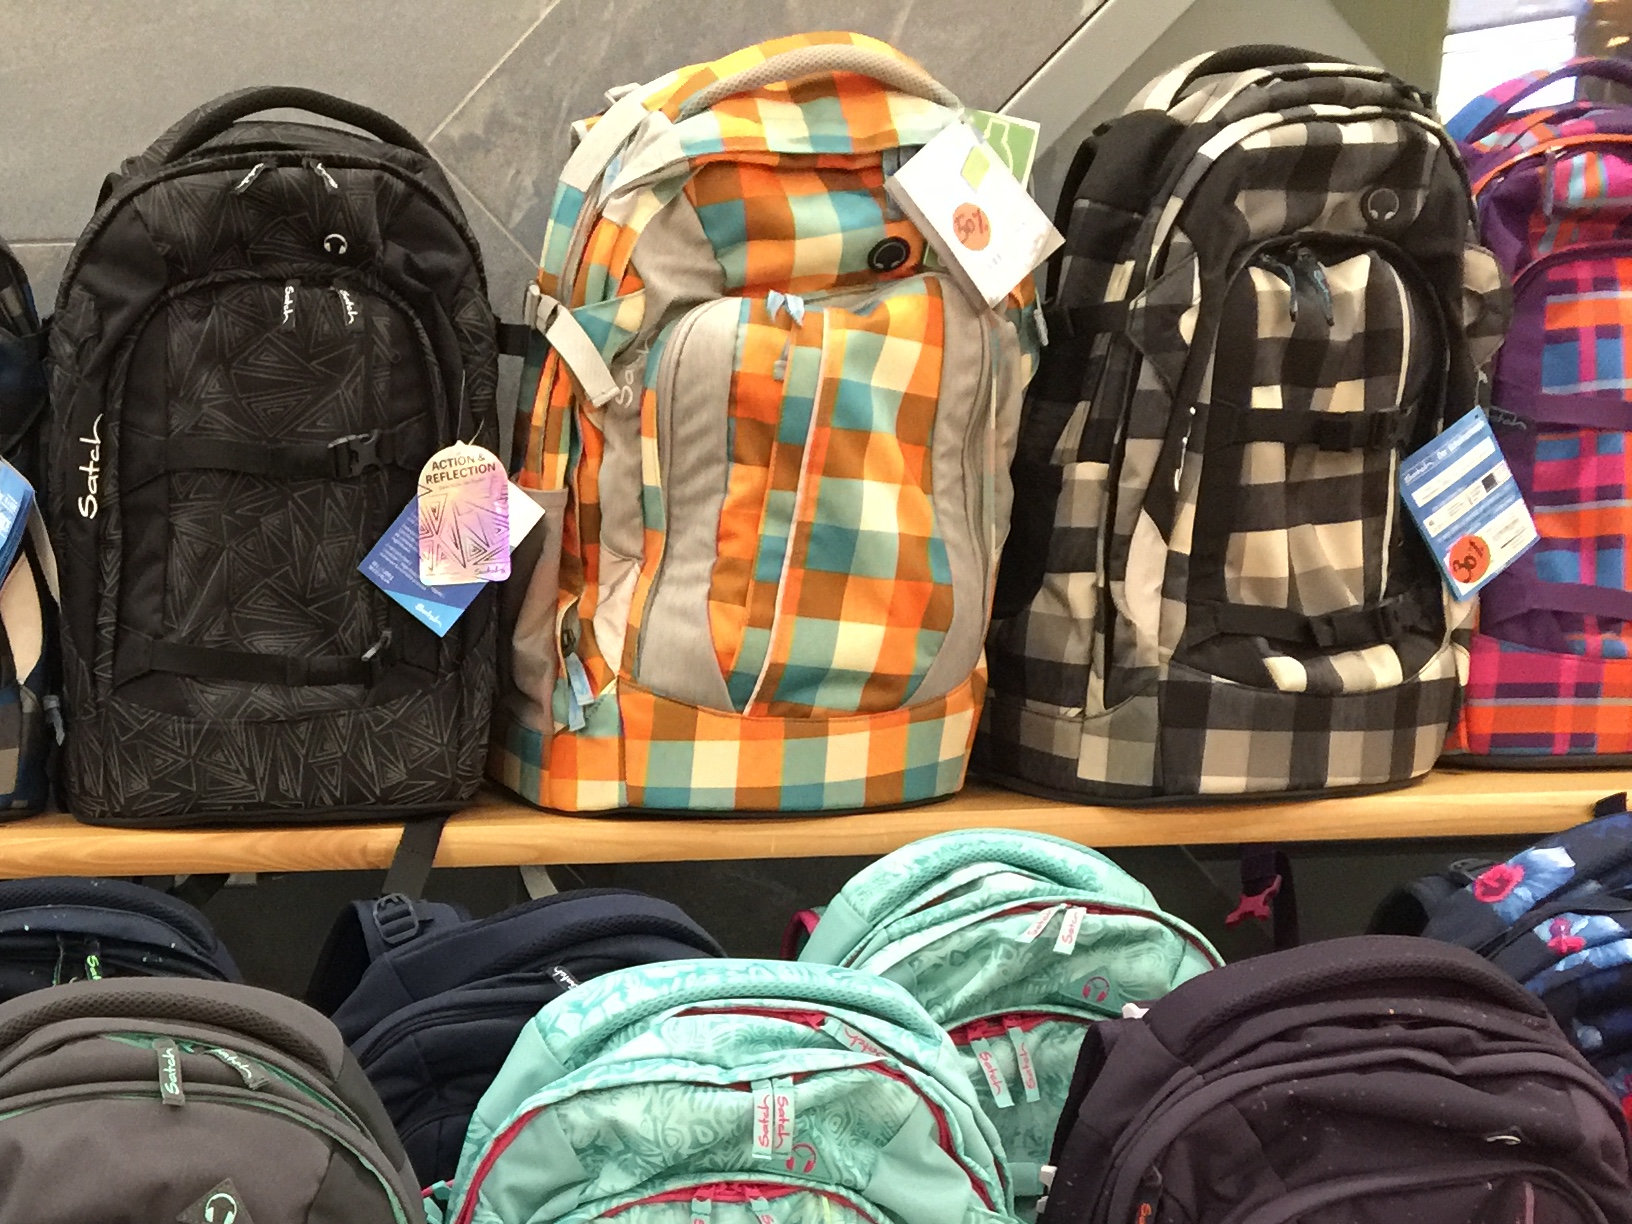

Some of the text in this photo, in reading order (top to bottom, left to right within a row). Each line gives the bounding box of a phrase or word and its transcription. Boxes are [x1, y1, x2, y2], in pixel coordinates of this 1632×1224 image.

[283, 285, 295, 324] Satch
[77, 412, 104, 520] Satch
[425, 462, 497, 485] REFLECTION
[431, 453, 486, 472] ACTION &
[162, 1047, 180, 1095] Satch
[979, 1051, 1002, 1096] Satch
[1021, 1042, 1036, 1090] Satch
[757, 1094, 770, 1149] Satch
[774, 1095, 790, 1149] Satch
